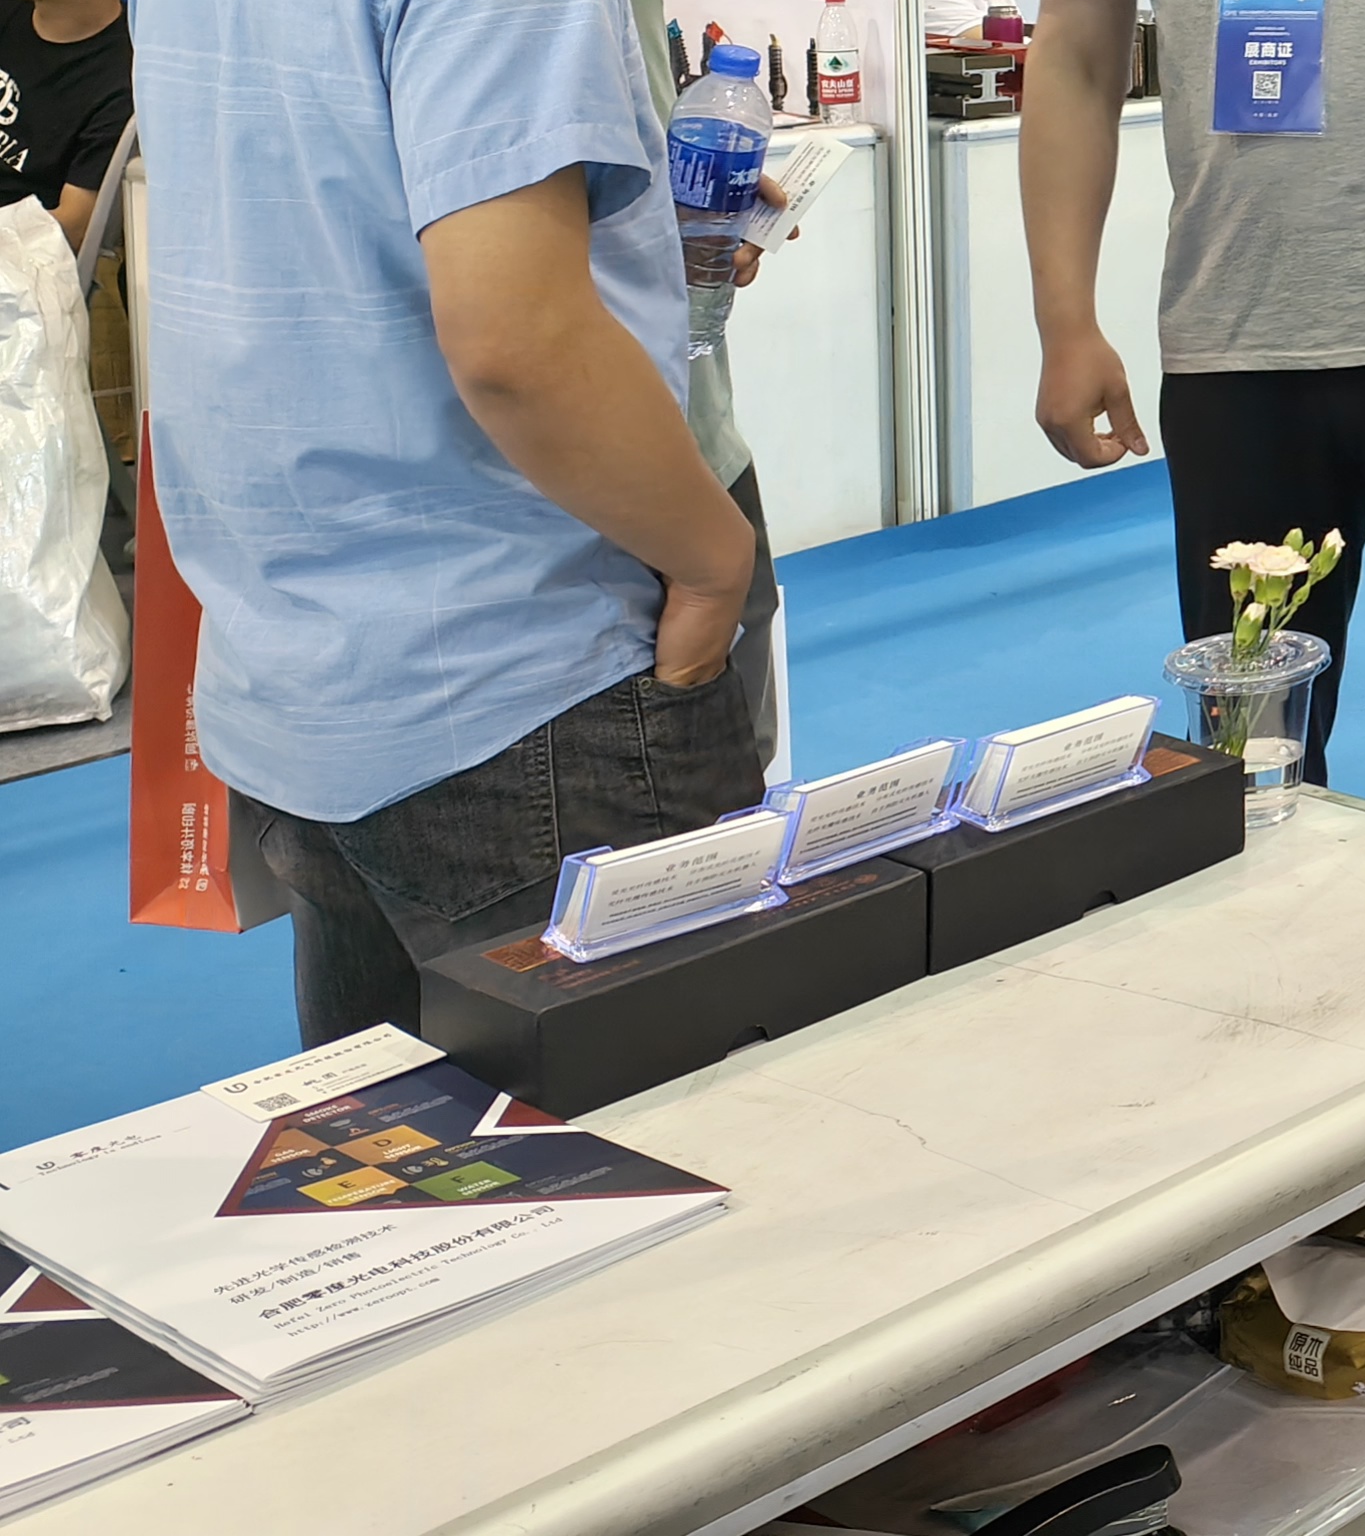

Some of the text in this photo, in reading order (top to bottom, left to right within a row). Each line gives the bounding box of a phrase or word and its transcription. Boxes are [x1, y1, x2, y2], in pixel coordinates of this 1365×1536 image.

[1243, 41, 1294, 59] 展商证
[213, 1222, 398, 1296] 先进光学传感检测技术
[258, 1204, 557, 1320] 合肥零度光电科技股份有限公司
[1289, 1331, 1323, 1358] 原木
